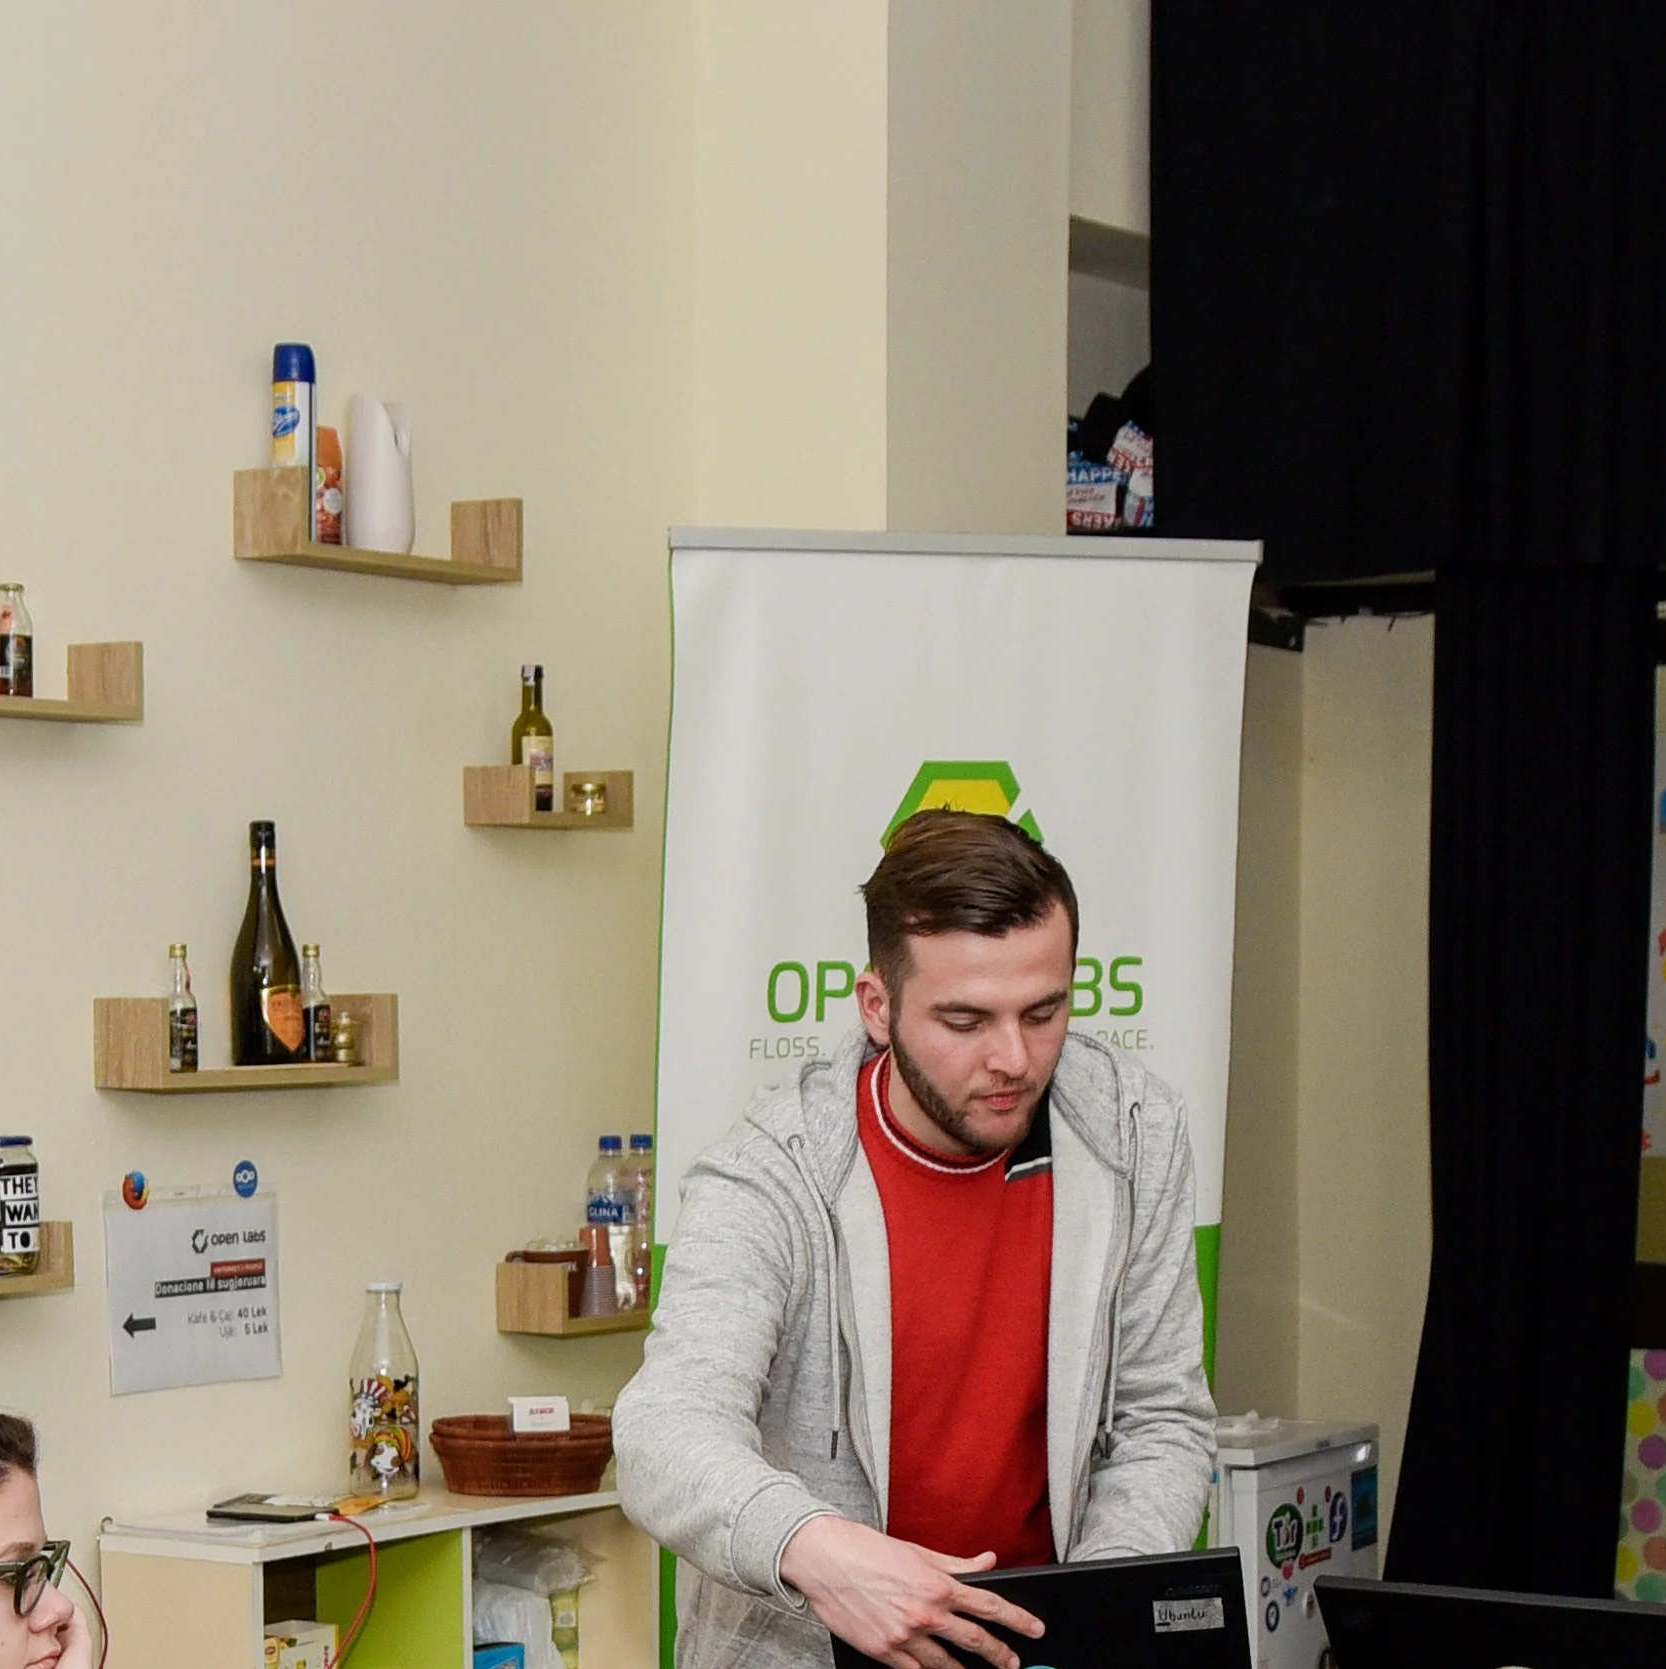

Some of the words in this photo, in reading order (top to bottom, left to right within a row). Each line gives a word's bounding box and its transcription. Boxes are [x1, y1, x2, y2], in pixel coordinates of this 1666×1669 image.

[749, 1036, 826, 1060] FLOSS.
[7, 1231, 31, 1249] TO
[155, 1281, 204, 1296] Donacione
[188, 1311, 208, 1324] Kafe
[237, 1307, 249, 1319] 40
[251, 1305, 268, 1318] Lek
[252, 1321, 269, 1334] Lek
[1158, 1608, 1205, 1626] Ubuntu
